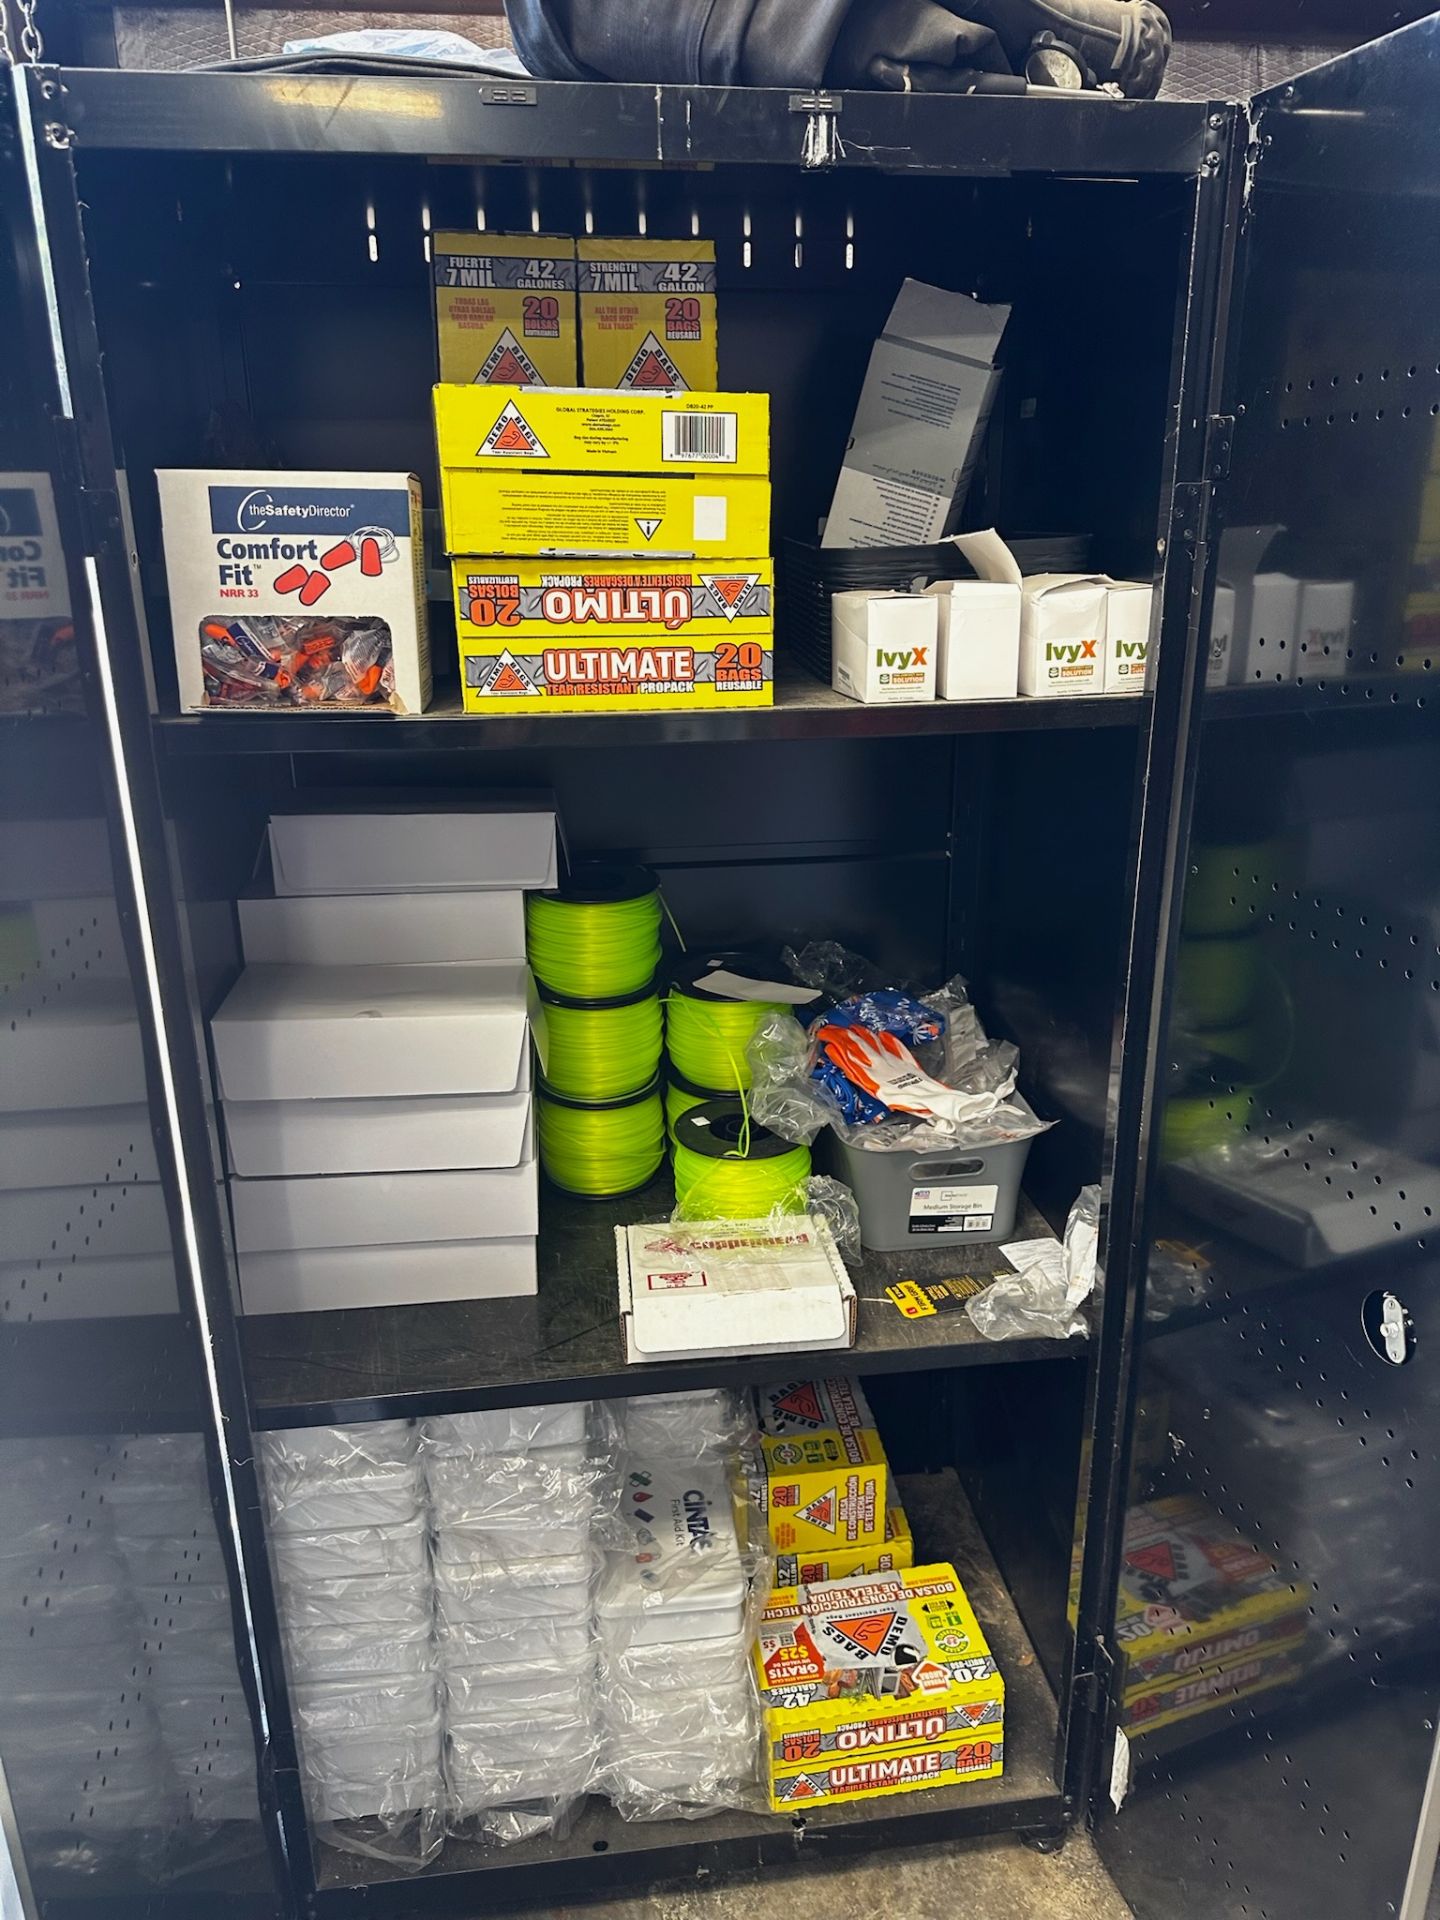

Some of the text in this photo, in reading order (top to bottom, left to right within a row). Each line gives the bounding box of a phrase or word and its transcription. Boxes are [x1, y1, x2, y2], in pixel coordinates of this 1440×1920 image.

[449, 256, 492, 269] FUERTE
[525, 259, 555, 279] 42
[590, 262, 638, 273] STRENGTH
[446, 268, 496, 287] 7 MIL
[664, 263, 698, 282] 42
[517, 279, 566, 290] GALONES
[590, 272, 638, 292] 7 MIL
[658, 281, 705, 292] GALLON
[523, 296, 560, 321] 20
[665, 298, 701, 321] 20
[525, 319, 558, 330] BOLSAS
[667, 320, 700, 331] BAGS
[667, 331, 700, 340] REUSABLE
[481, 345, 537, 380] DEMO BAGS
[626, 348, 679, 382] DEMO BAGS
[487, 415, 538, 447] DEMO BAGS
[249, 503, 350, 518] theSafetyDirector
[217, 538, 318, 560] Comfort
[468, 576, 519, 585] REUTILIZABLES
[541, 575, 583, 588] PROPACK
[584, 576, 634, 587] DESGARRES
[641, 575, 691, 586] RESISTENTE
[220, 589, 259, 598] NRR 33
[469, 584, 519, 598] BOLSAS
[709, 583, 752, 609] DEMO BAGS
[469, 598, 521, 627] 20
[544, 587, 691, 630] ÚLTIMO
[714, 642, 762, 668] 20
[877, 647, 928, 670] IvyX
[1045, 639, 1097, 664] IvyX
[545, 647, 694, 682] ULTIMATE
[1062, 669, 1092, 677] SOLUTION
[487, 661, 531, 688] DEMO BAGS
[716, 668, 761, 681] BAGS
[545, 681, 695, 696] TEAR RESISTANT PROPACK
[716, 681, 762, 691] REUSABLE
[949, 1202, 972, 1210] Storage
[915, 1296, 929, 1310] FIRM
[772, 1409, 819, 1429] DEMO
[842, 1395, 861, 1427] DE TELA
[840, 1423, 863, 1464] BOLSA DE
[772, 1486, 788, 1508] 20
[864, 1480, 876, 1532] DE TELA TEJIDA
[840, 1498, 849, 1521] BOLSA
[847, 1475, 858, 1540] DE CONSTRUCCIÓN
[857, 1495, 865, 1520] HECHA
[671, 1499, 683, 1547] First Aid Kit
[810, 1587, 849, 1604] TEJIDA
[851, 1584, 880, 1598] TELA
[881, 1582, 898, 1592] DE
[898, 1588, 915, 1598] DE
[916, 1582, 955, 1598] BOLSA
[801, 1591, 897, 1616] CONSTRUCCIÓN
[845, 1609, 878, 1617] Resistant
[822, 1625, 869, 1660] BAGS
[881, 1615, 908, 1656] DEMO
[779, 1644, 809, 1660] $25
[768, 1663, 819, 1679] GRATIS
[953, 1665, 991, 1683] 20
[770, 1683, 817, 1695] GALONES
[781, 1692, 812, 1709] 42
[836, 1721, 867, 1733] PROPACK
[836, 1715, 947, 1751] ÚLTIMO
[784, 1733, 820, 1746] BOLSAS
[784, 1741, 821, 1762] 20
[956, 1741, 993, 1760] 20
[829, 1752, 940, 1788] ULTIMATE
[956, 1756, 992, 1768] BAGS
[956, 1763, 992, 1774] REUSABLE
[830, 1771, 941, 1795] TEAR RESISTANT PROPACK
